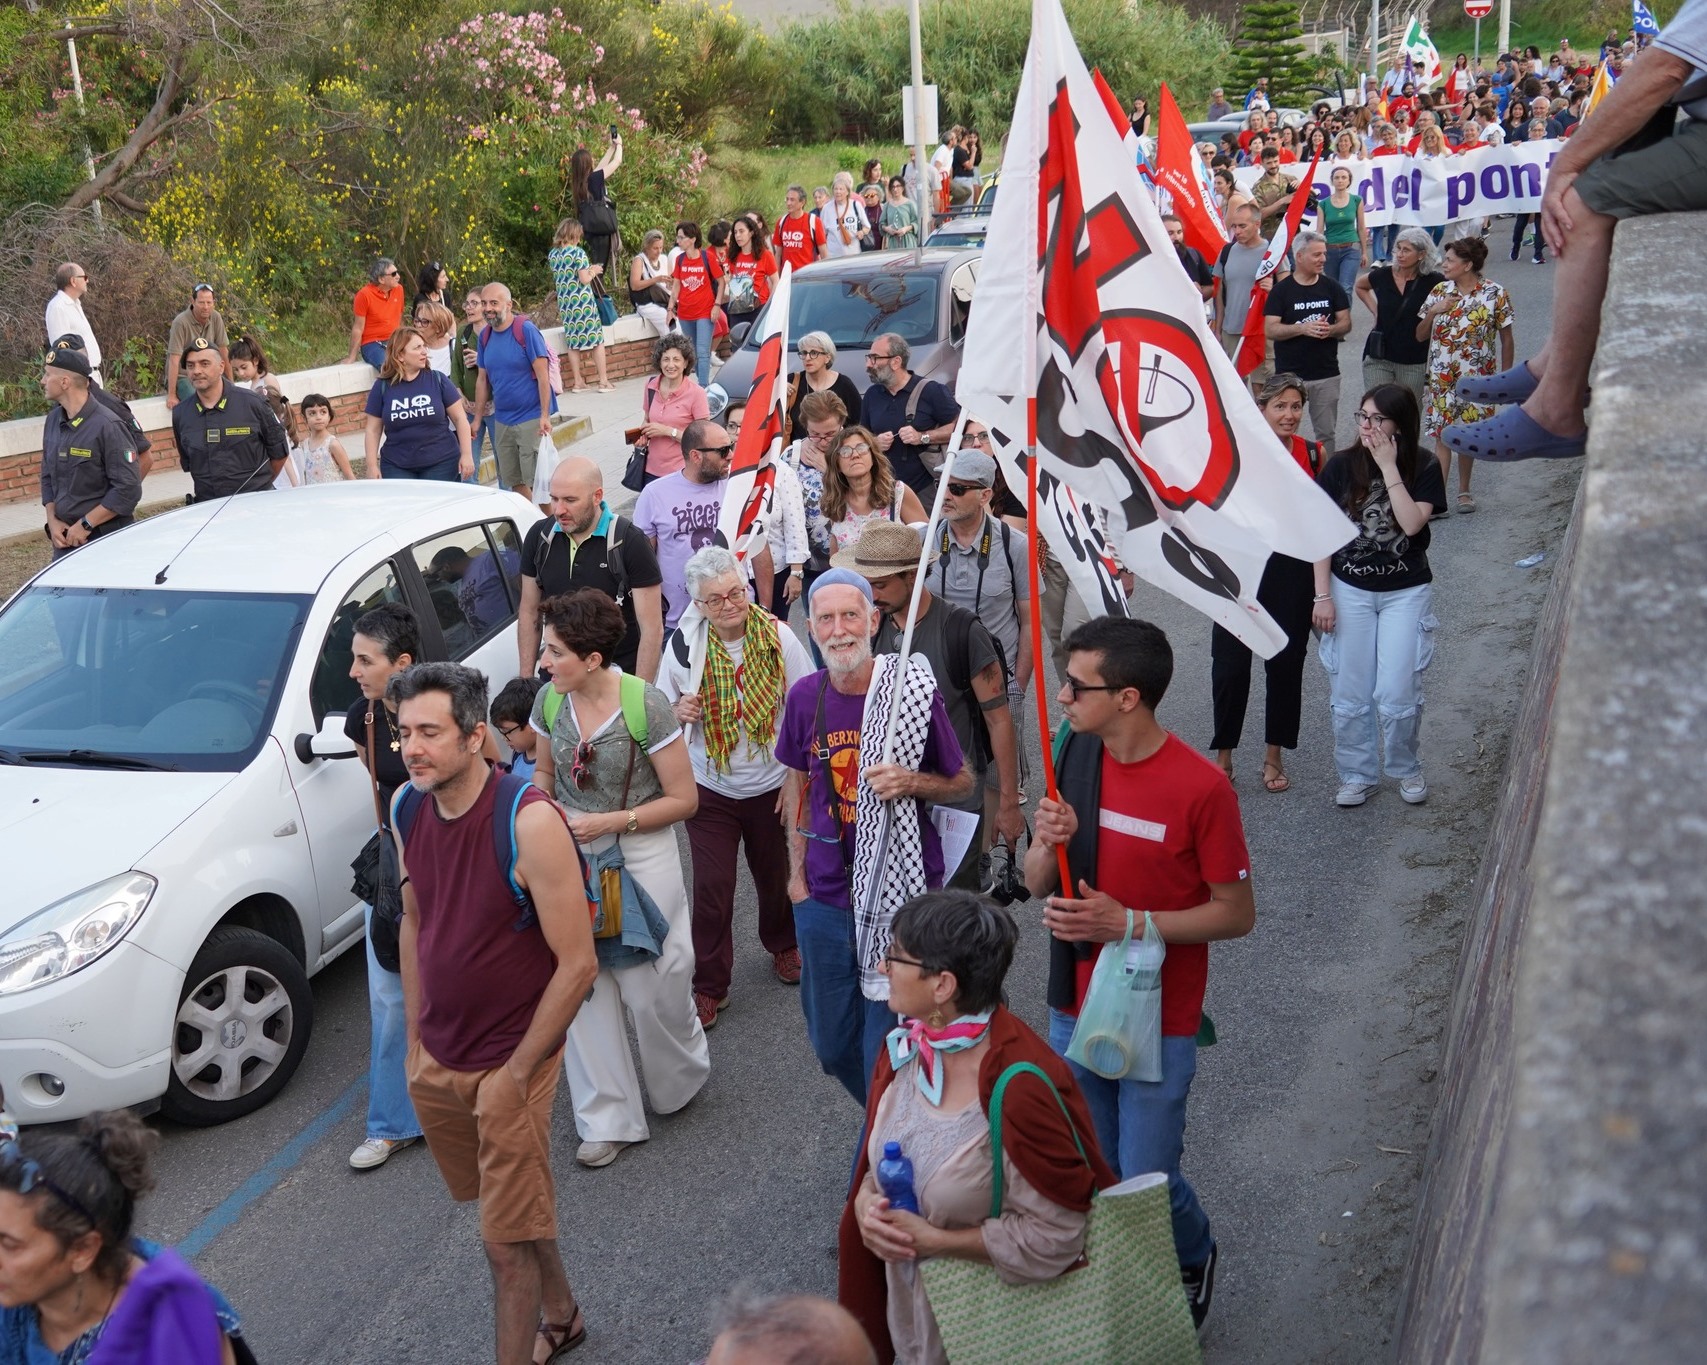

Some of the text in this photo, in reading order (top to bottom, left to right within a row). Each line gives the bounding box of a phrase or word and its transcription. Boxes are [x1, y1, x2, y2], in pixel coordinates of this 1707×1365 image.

[1358, 167, 1422, 213] del
[1447, 152, 1559, 219] pon
[782, 231, 804, 241] NO
[1294, 300, 1330, 310] NO PONTE
[391, 394, 431, 411] NO
[390, 406, 435, 421] PONTE
[1105, 815, 1162, 838] JEANS
